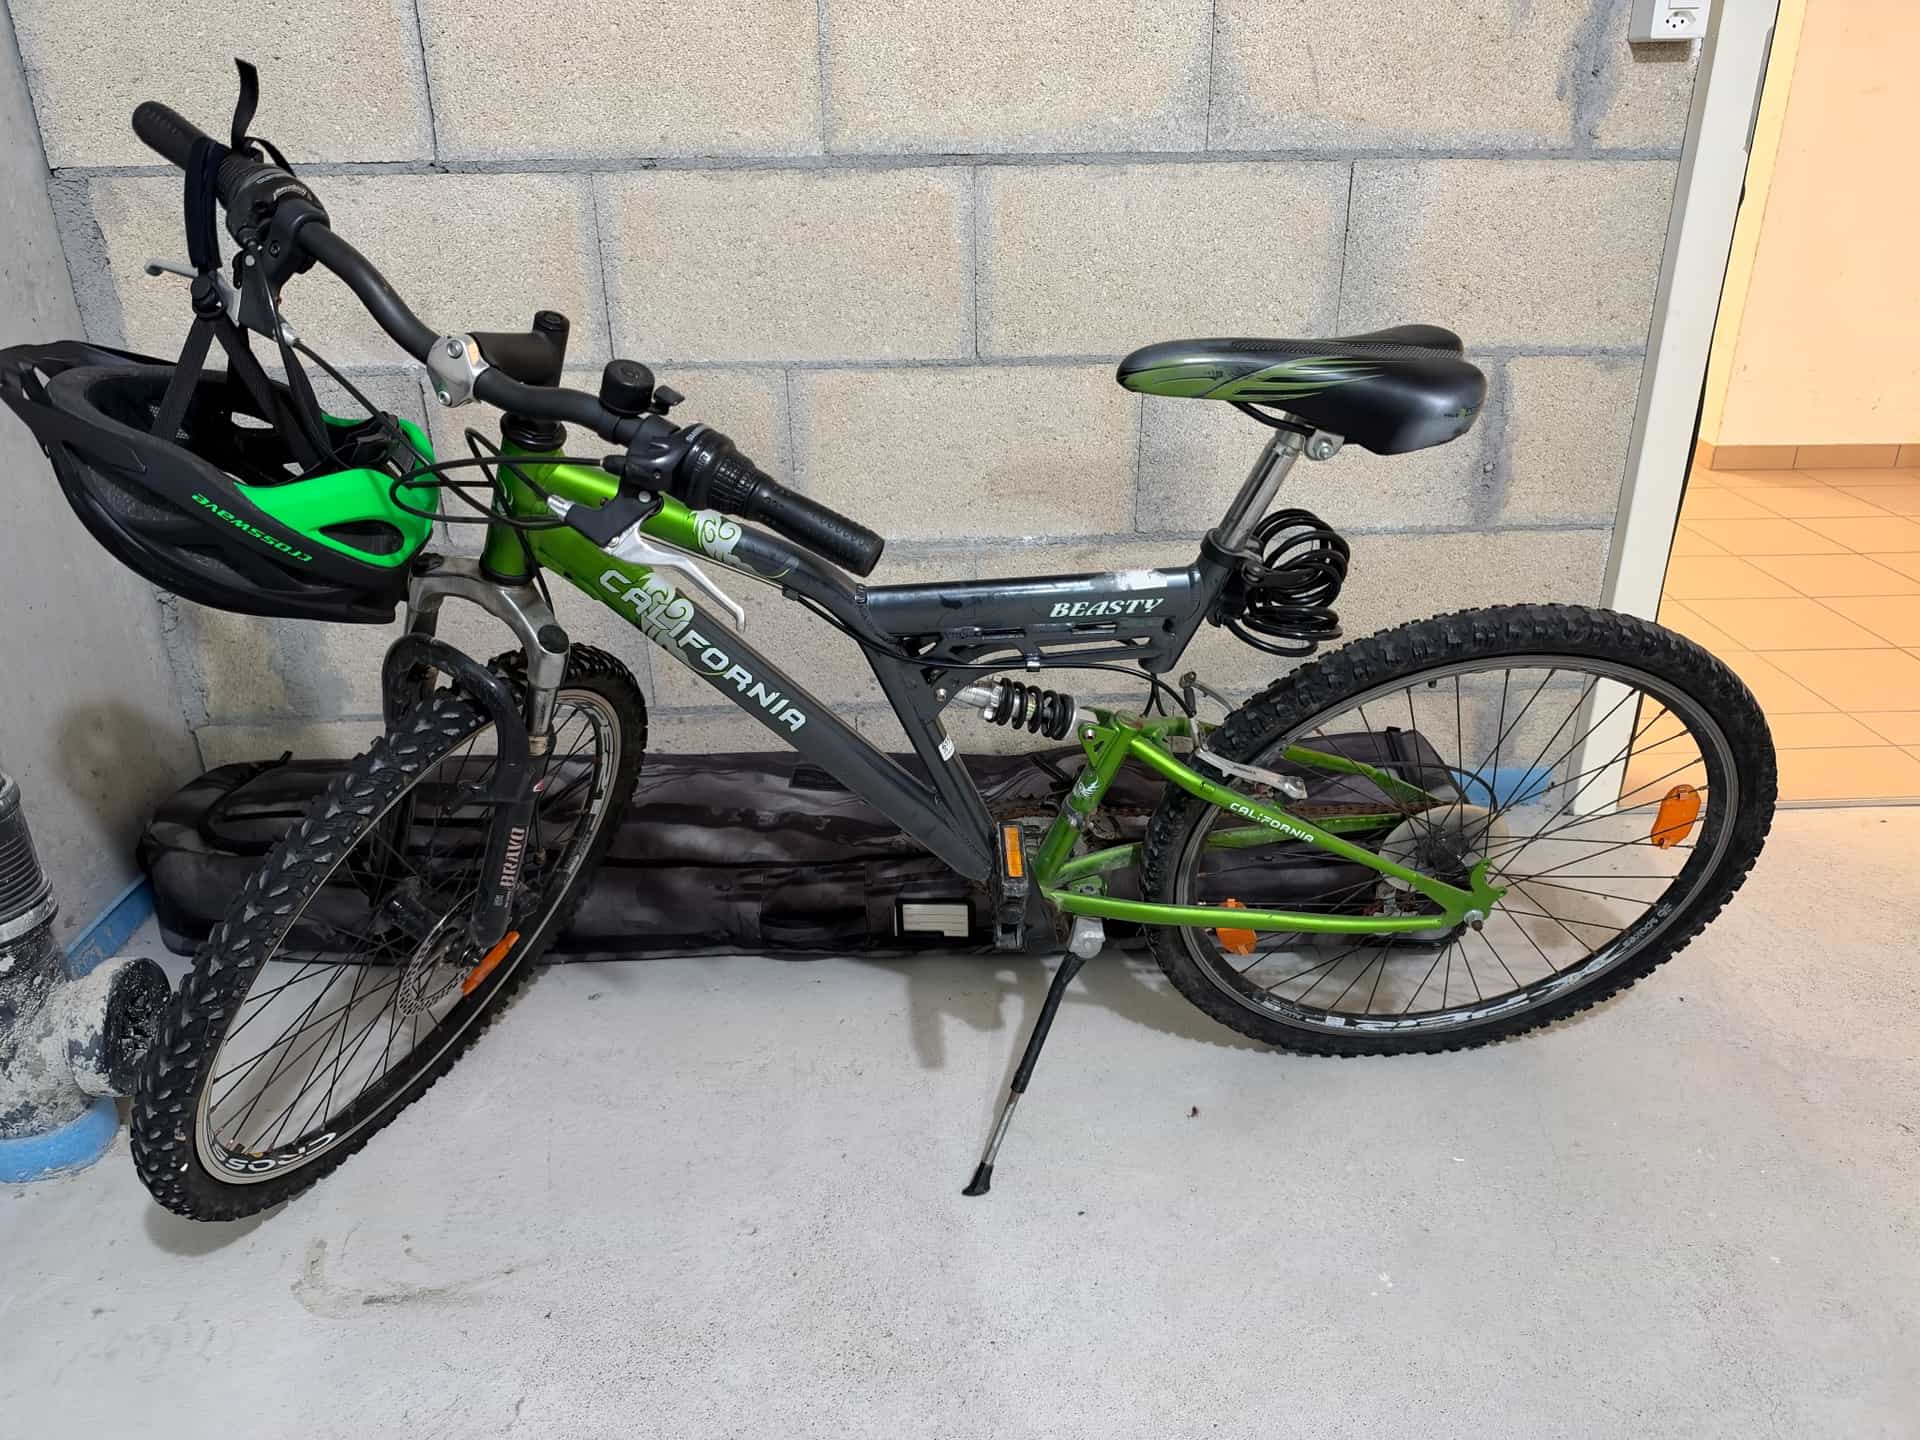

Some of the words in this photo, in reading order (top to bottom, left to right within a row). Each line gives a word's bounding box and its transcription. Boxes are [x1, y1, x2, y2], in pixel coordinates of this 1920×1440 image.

[192, 493, 312, 562] crosswave
[1050, 598, 1164, 618] BEASTY
[600, 570, 807, 732] CALIFORNIA
[1230, 803, 1314, 843] CALIFORNIA
[501, 827, 526, 888] BRAVO
